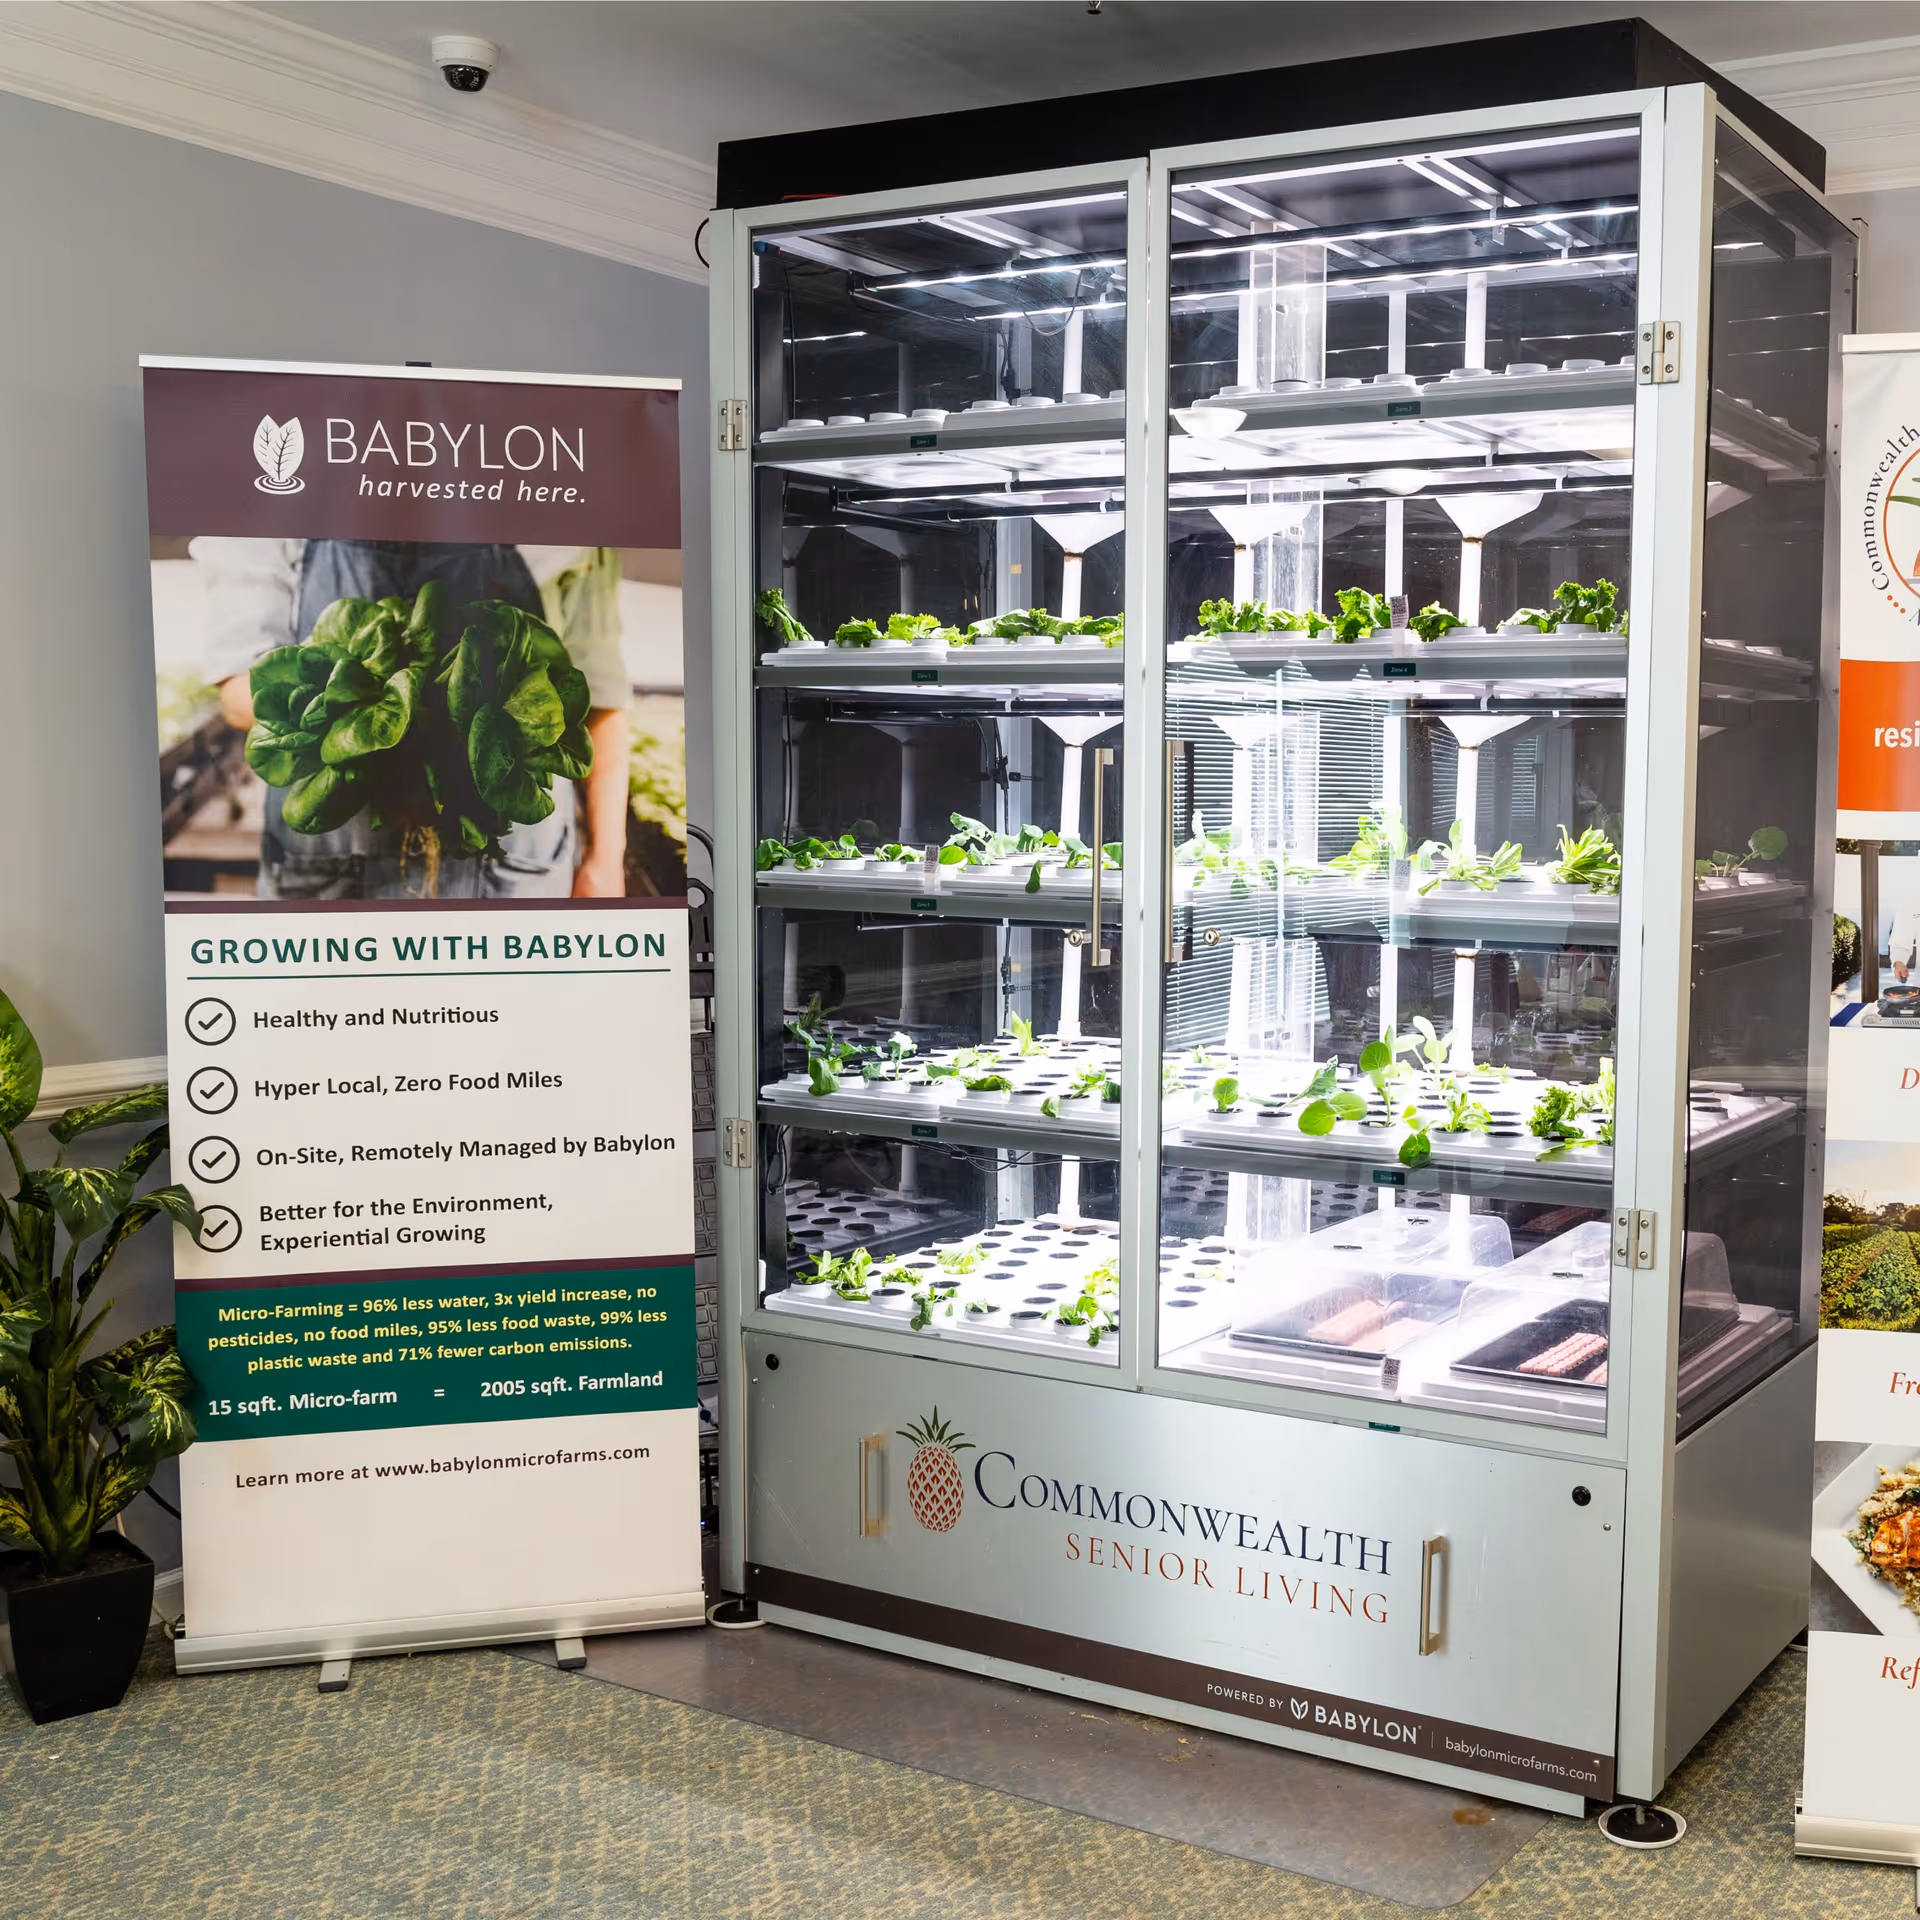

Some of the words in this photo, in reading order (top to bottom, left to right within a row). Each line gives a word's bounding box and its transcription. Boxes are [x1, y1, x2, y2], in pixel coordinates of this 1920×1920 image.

[326, 418, 584, 473] BABYLON
[358, 473, 504, 501] harvested
[517, 479, 585, 504] here.
[1864, 425, 1920, 590] Commonwealth
[1874, 720, 1920, 748] resi
[190, 936, 378, 965] GROWING
[392, 935, 488, 961] WITH
[504, 933, 665, 960] BABYLON
[253, 1009, 338, 1031] Healthy
[344, 1007, 385, 1026] and
[392, 1006, 499, 1025] Nutritious
[254, 1080, 321, 1101] Hyper
[327, 1075, 388, 1096] Local,
[394, 1075, 442, 1092] Zero
[449, 1071, 500, 1091] Food
[507, 1070, 563, 1089] Miles
[256, 1146, 344, 1166] On-Site,
[351, 1141, 453, 1162] Remotely
[459, 1136, 556, 1159] Managed
[563, 1136, 588, 1157] by
[594, 1133, 675, 1155] Babylon
[260, 1204, 327, 1222] Better
[332, 1200, 364, 1218] for
[369, 1198, 406, 1217] the
[413, 1193, 553, 1214] Environment,
[260, 1227, 389, 1254] Experiential
[396, 1224, 486, 1244] Growing
[218, 1302, 344, 1322] Micro-Farming
[362, 1298, 398, 1313] 96%
[402, 1296, 434, 1311] less
[438, 1295, 489, 1309] water,
[494, 1292, 513, 1306] 3x
[517, 1288, 557, 1308] yield
[561, 1288, 632, 1302] increase,
[637, 1287, 657, 1299] no
[208, 1330, 299, 1351] pesticides,
[304, 1330, 326, 1342] no
[329, 1324, 369, 1340] food
[374, 1322, 423, 1338] miles,
[427, 1319, 463, 1335] 95%
[467, 1318, 498, 1332] less
[501, 1314, 539, 1331] food
[543, 1314, 596, 1328] waste,
[600, 1310, 634, 1325] 99%
[638, 1309, 668, 1323] less
[247, 1354, 303, 1375] plastic
[307, 1352, 358, 1367] waste
[362, 1348, 393, 1364] and
[398, 1346, 433, 1362] 71%
[436, 1345, 485, 1359] fewer
[488, 1340, 545, 1356] carbon
[549, 1336, 632, 1352] emissions.
[208, 1399, 232, 1416] 15
[237, 1395, 283, 1417] sqft.
[289, 1389, 398, 1410] Micro-farm
[480, 1379, 526, 1397] 2005
[530, 1376, 573, 1396] sqft.
[578, 1370, 663, 1391] Farmland
[236, 1473, 289, 1489] Learn
[295, 1469, 345, 1484] more
[350, 1465, 369, 1480] at
[374, 1447, 650, 1478] www.babylonmicrofarms.com
[1066, 1532, 1215, 1589] SENIOR
[1237, 1565, 1389, 1624] LIVING
[1207, 1683, 1264, 1705] POWERED
[1269, 1697, 1284, 1710] BY
[1314, 1704, 1418, 1745] BABYLON
[1445, 1737, 1598, 1784] babylonmicrofarms.com
